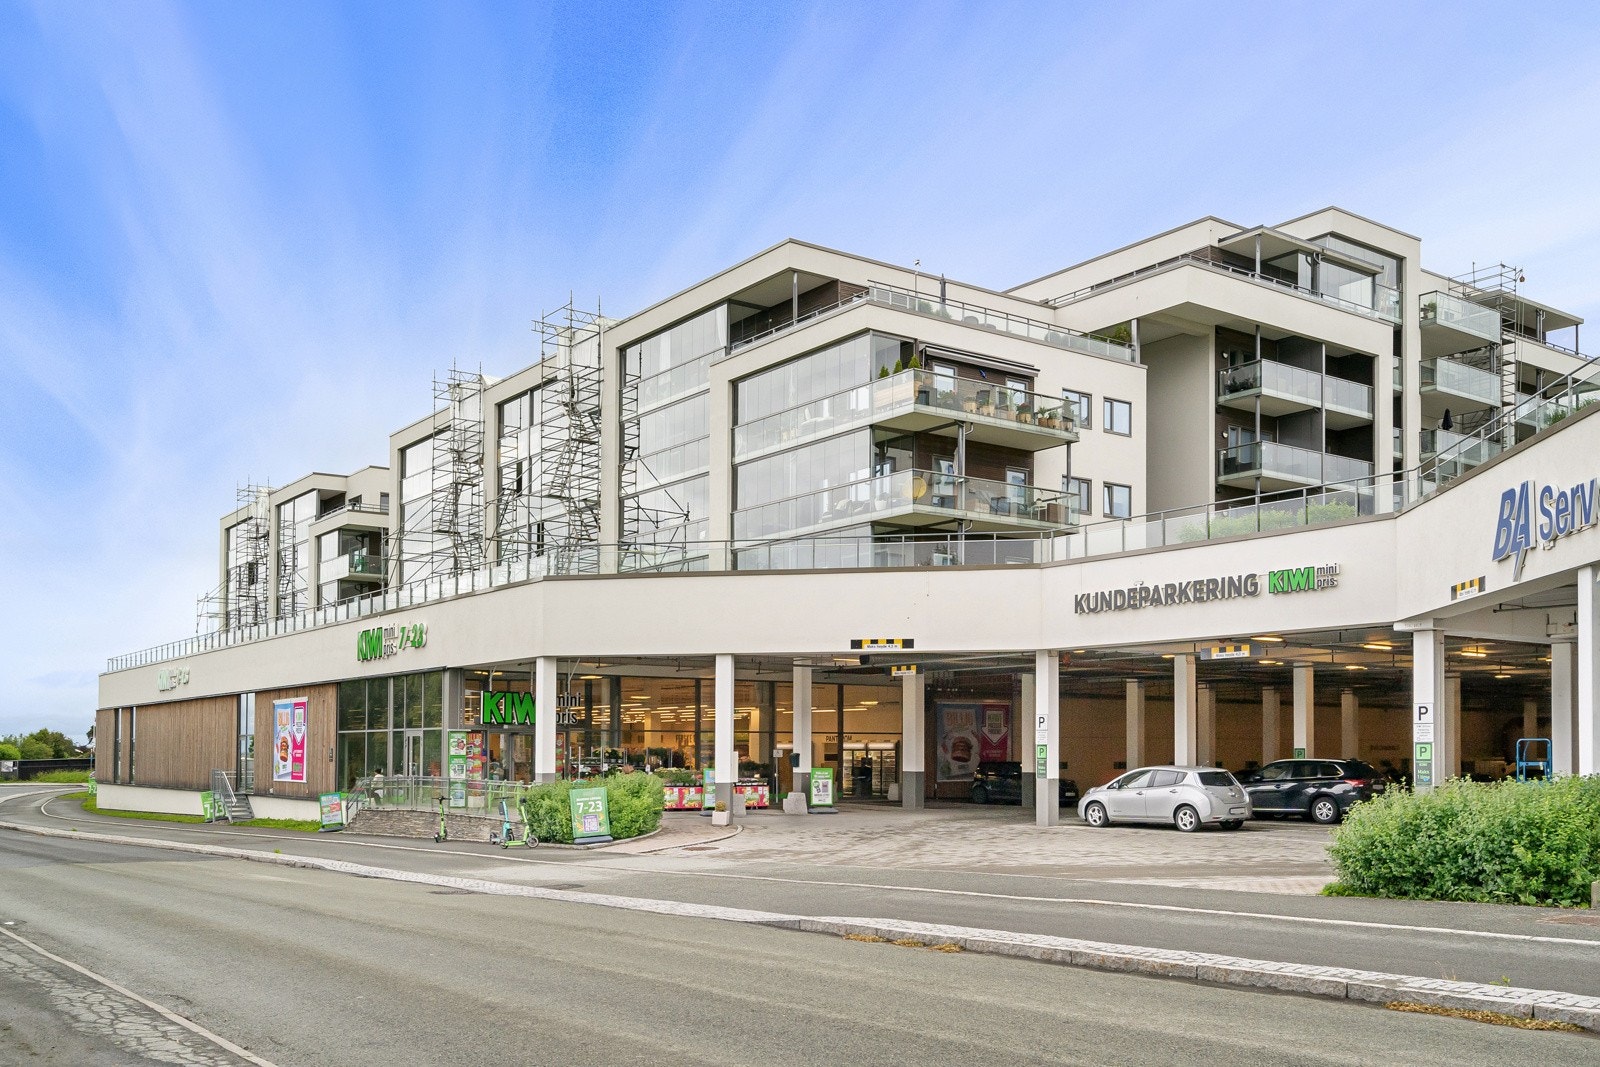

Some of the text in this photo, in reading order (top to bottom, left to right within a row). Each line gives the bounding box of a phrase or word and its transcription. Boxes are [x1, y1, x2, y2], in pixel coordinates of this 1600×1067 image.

[1540, 479, 1600, 541] Serv
[1316, 562, 1336, 575] mini
[1074, 566, 1315, 614] KUNDEPARKERING KIWI
[1316, 575, 1335, 590] pris
[357, 626, 383, 662] KIWI
[482, 690, 536, 725] KIW
[1418, 706, 1428, 721] P
[1038, 716, 1046, 728] P
[1039, 747, 1045, 757] P
[1420, 746, 1428, 758] P
[576, 800, 603, 814] 7-23
